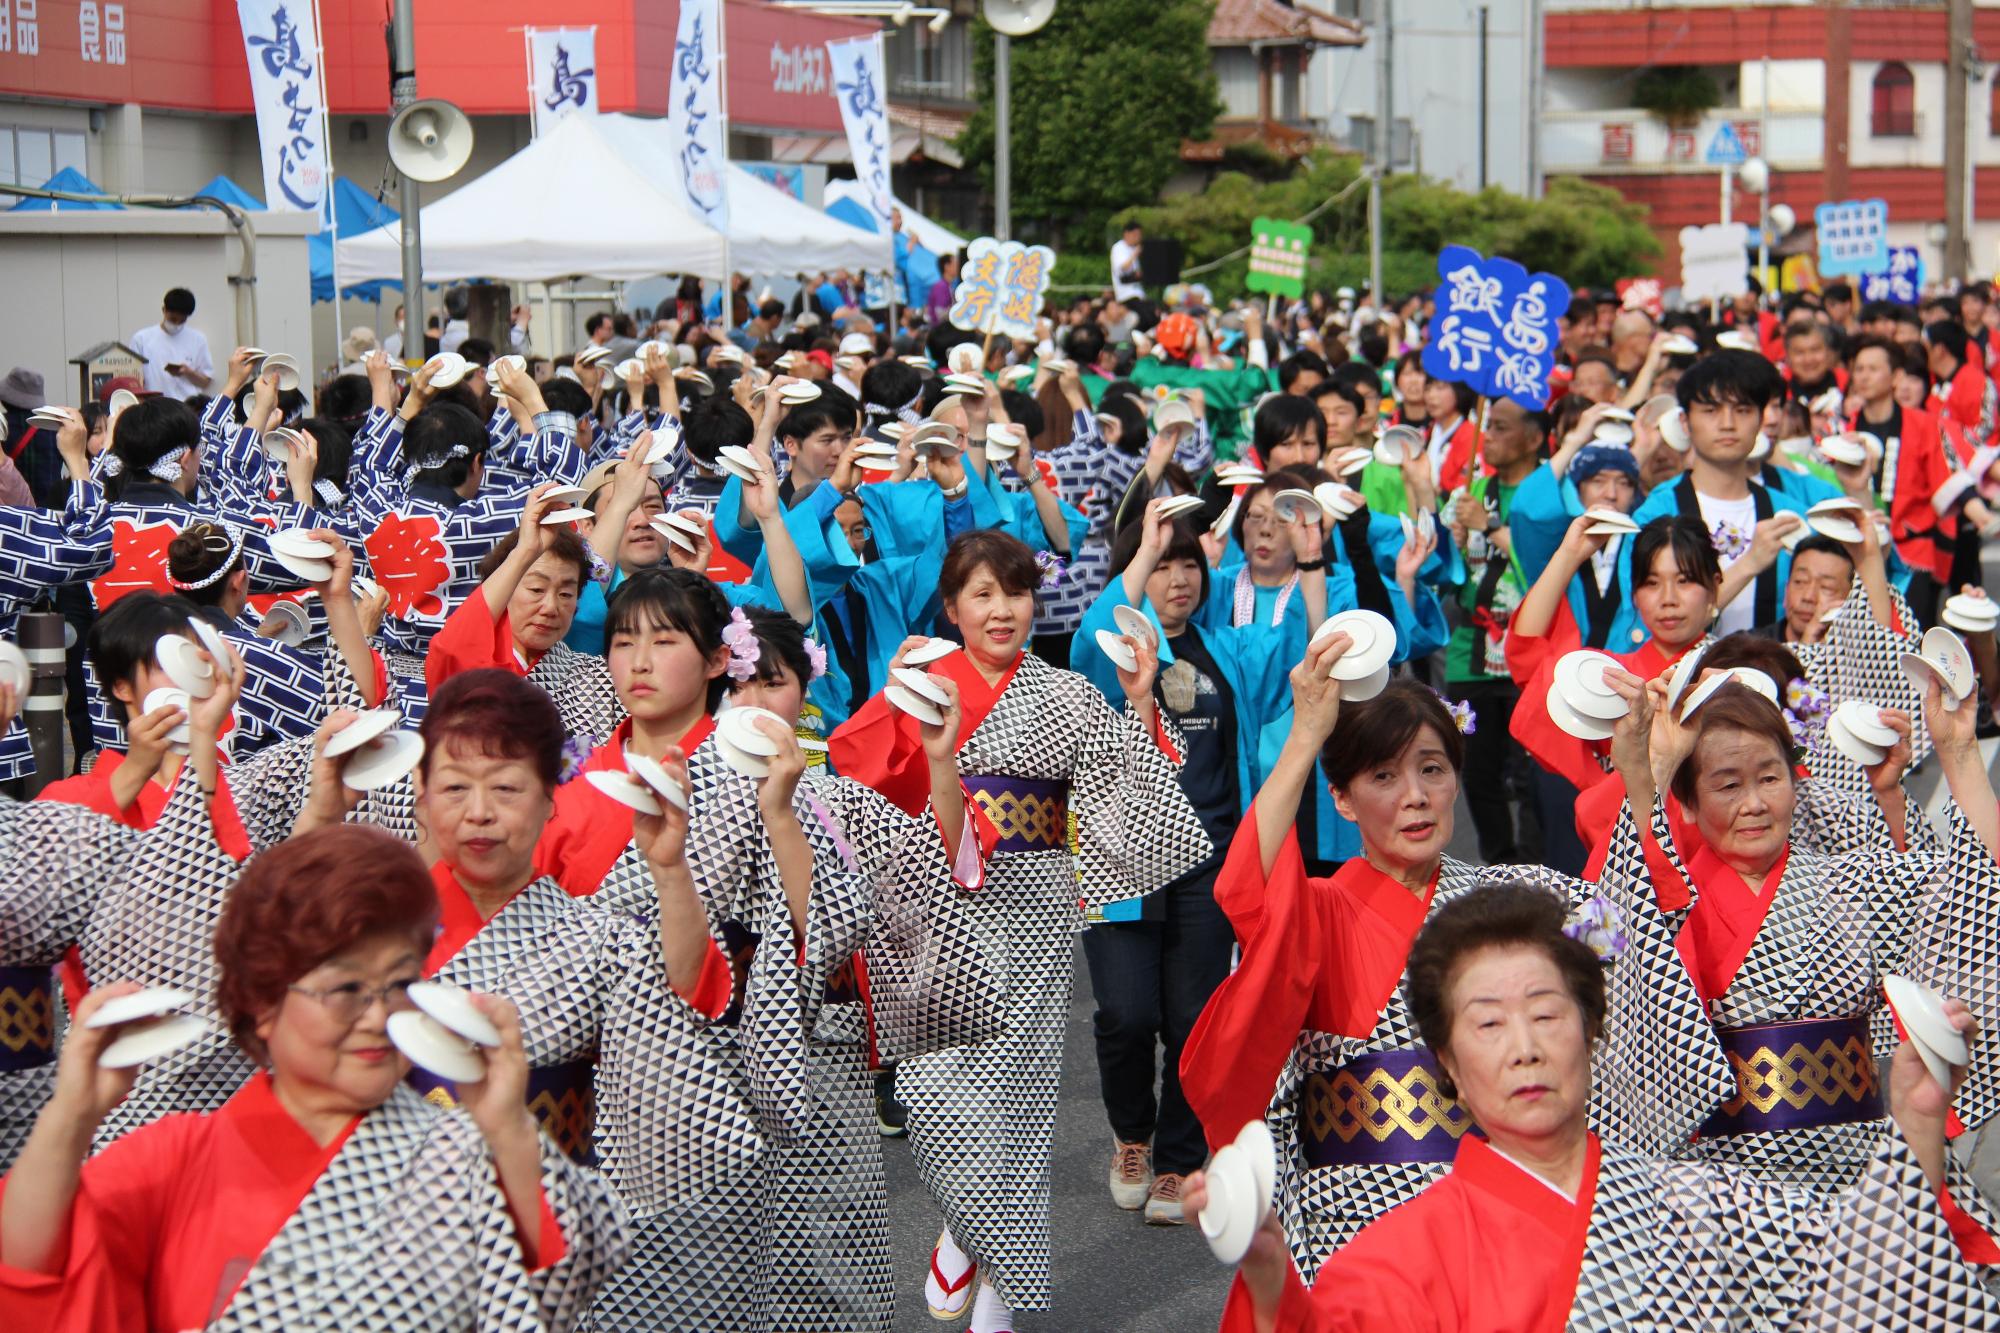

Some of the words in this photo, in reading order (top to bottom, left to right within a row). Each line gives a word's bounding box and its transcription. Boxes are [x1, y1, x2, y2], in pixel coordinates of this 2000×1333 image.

[79, 1, 126, 65] 食品
[954, 251, 1000, 325] 支庁
[1002, 250, 1042, 325] 隠岐
[1437, 265, 1504, 372] 銀行
[1494, 280, 1549, 400] 島根
